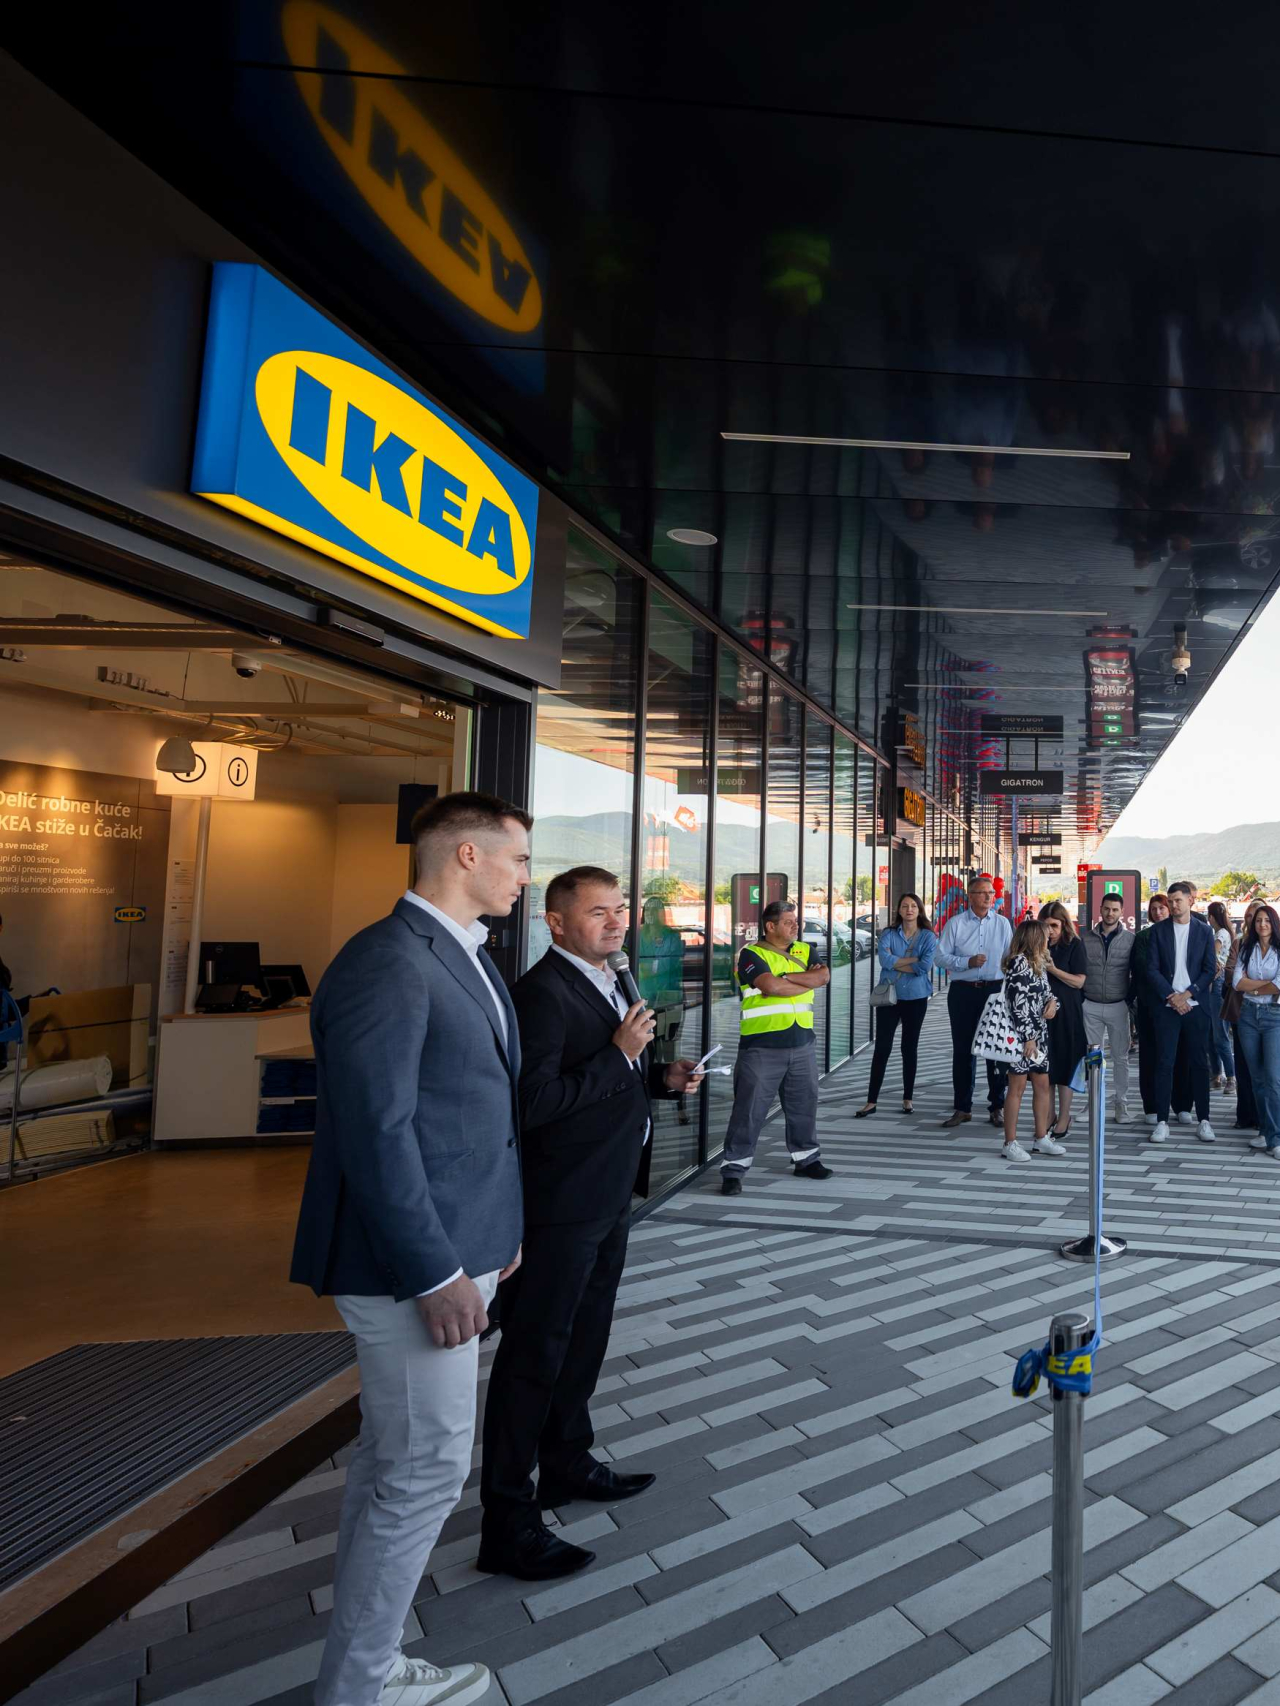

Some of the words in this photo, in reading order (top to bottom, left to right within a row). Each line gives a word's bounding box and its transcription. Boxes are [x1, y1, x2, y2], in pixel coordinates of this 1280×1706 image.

[288, 365, 517, 579] IKEA
[1000, 779, 1044, 787] GIGATRON
[41, 795, 91, 814] robne
[95, 801, 131, 818] kuće
[35, 818, 75, 835] stiže
[79, 824, 89, 836] u
[93, 819, 143, 839] Čačak!
[20, 842, 49, 850] možeš?
[11, 855, 21, 863] do
[23, 855, 36, 863] 100
[37, 856, 60, 864] sitnica
[22, 867, 52, 875] preuzmi
[53, 867, 87, 875] proizvode
[20, 875, 48, 884] kuhinje
[52, 876, 95, 885] garderobere
[1109, 884, 1120, 894] D
